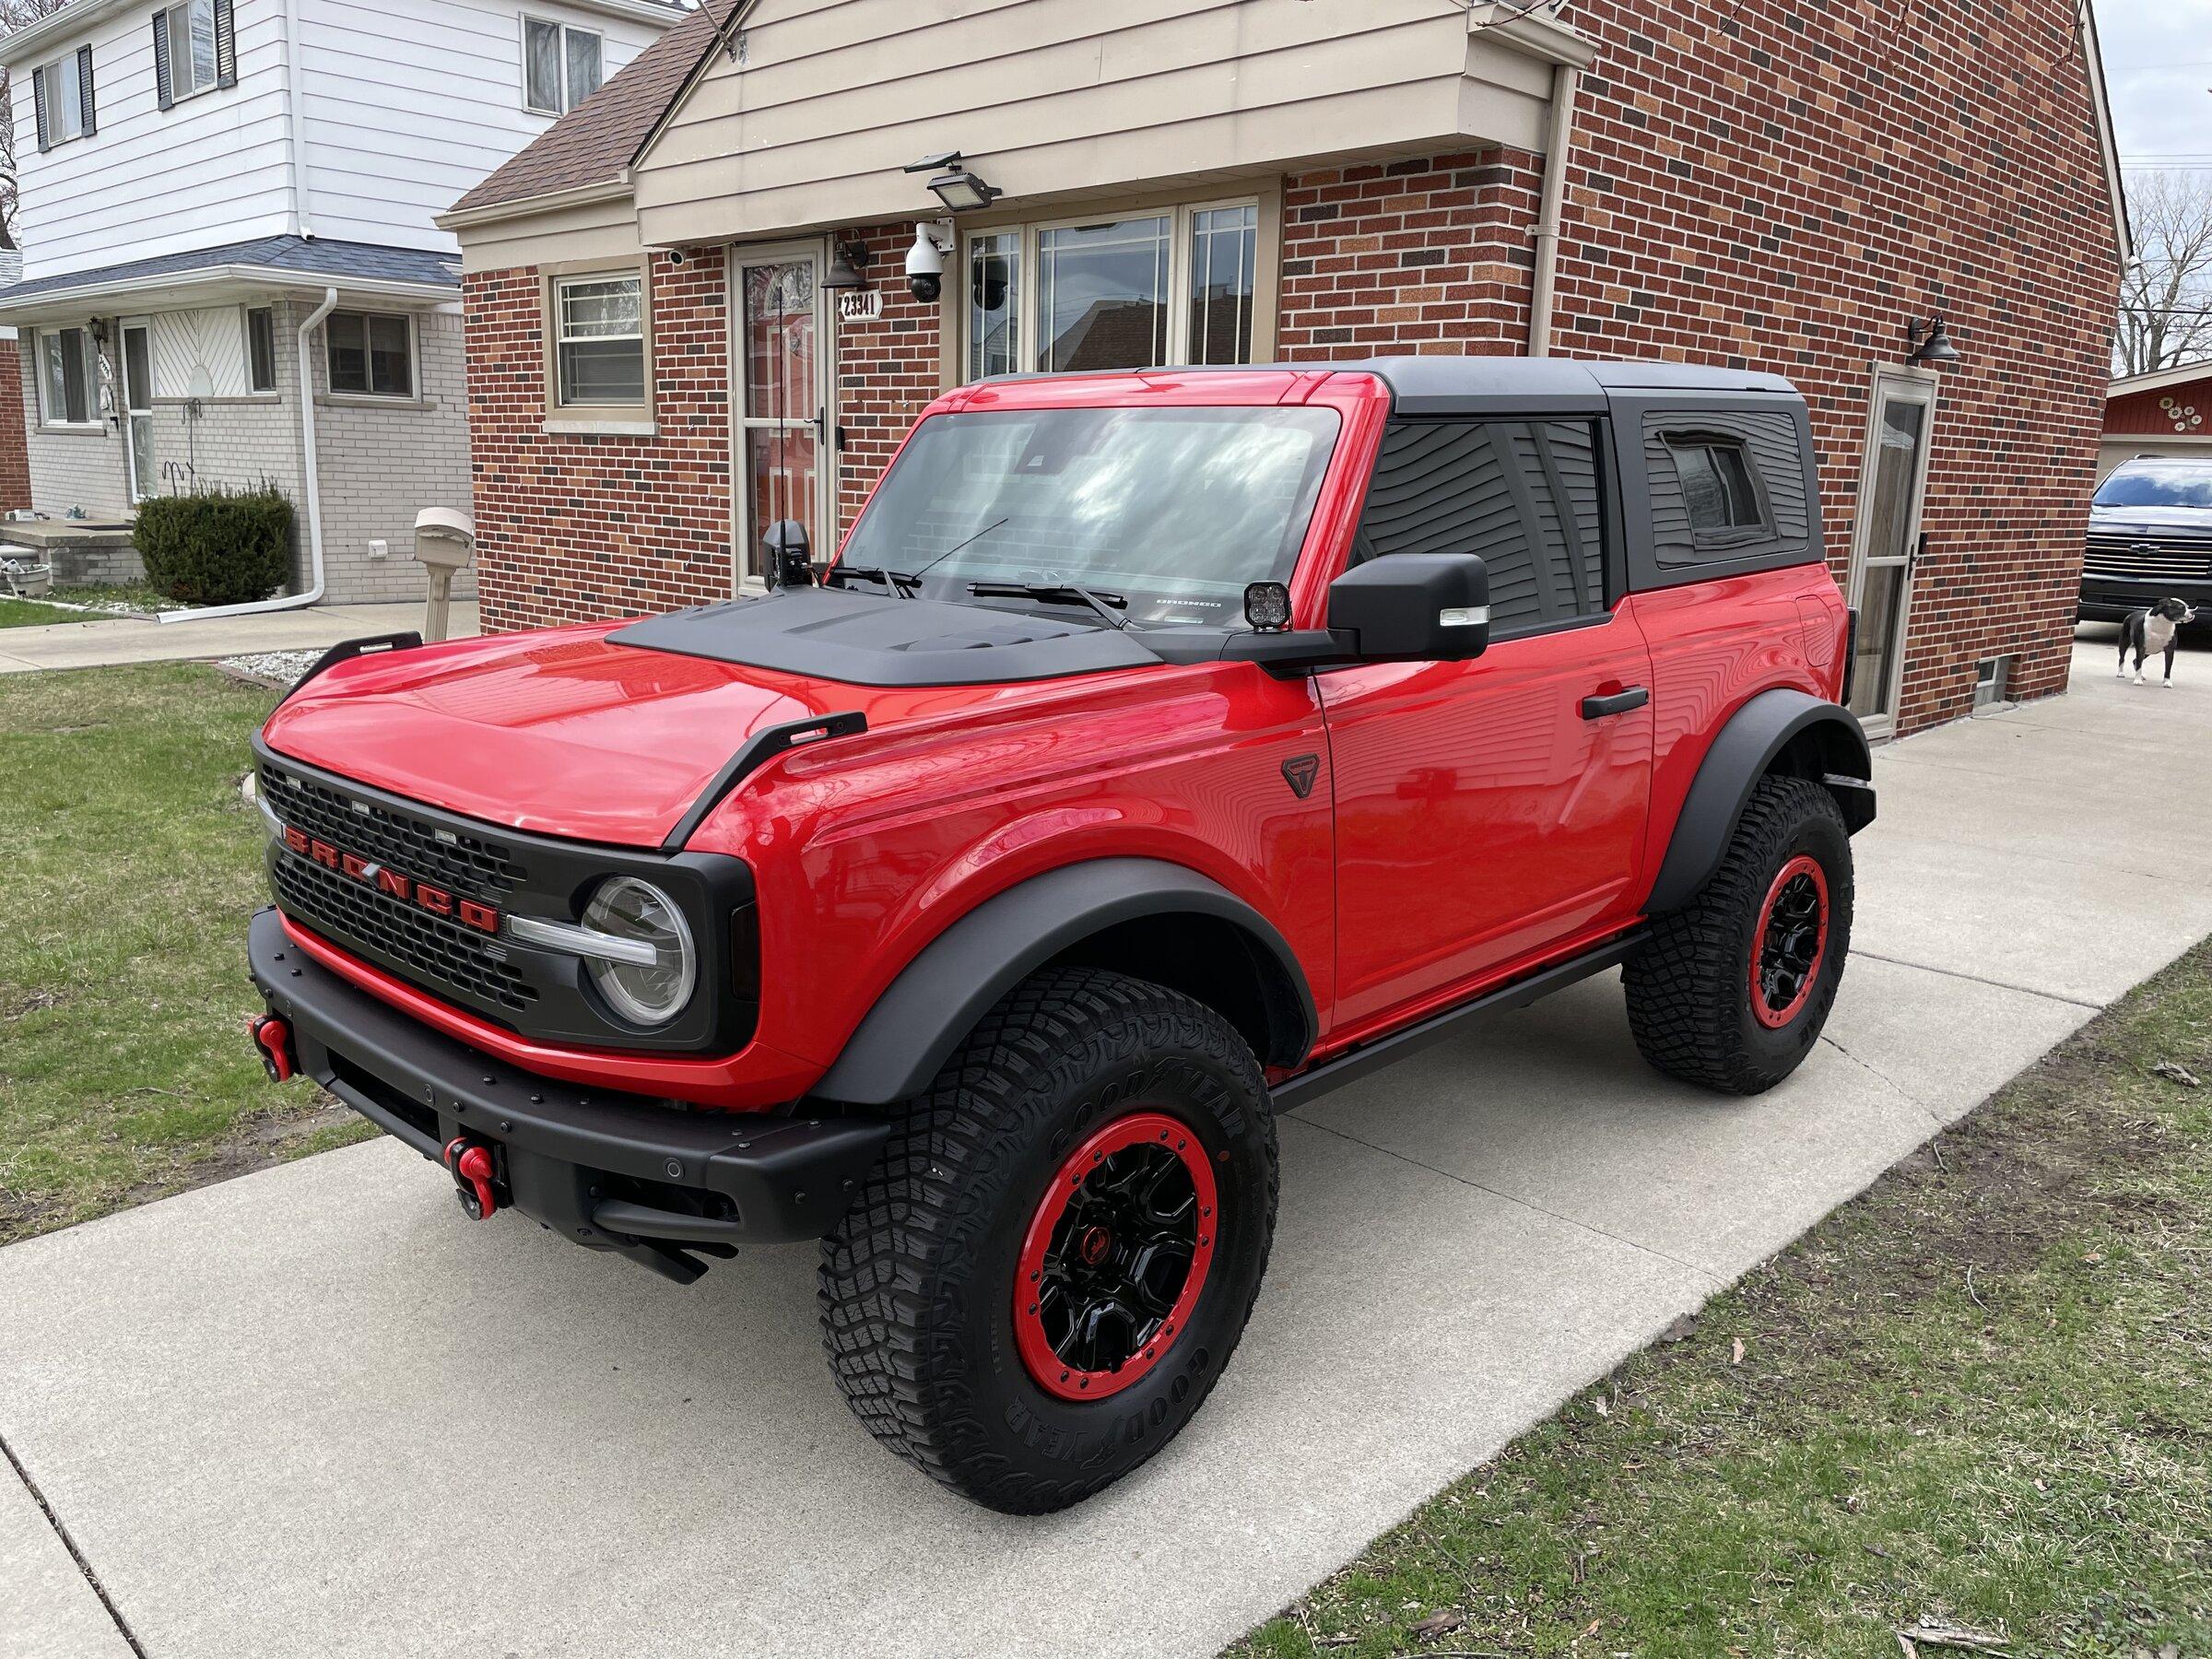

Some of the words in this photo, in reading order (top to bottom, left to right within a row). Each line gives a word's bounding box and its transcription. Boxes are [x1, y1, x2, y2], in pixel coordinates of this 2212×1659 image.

[844, 294, 875, 316] 23341
[1157, 599, 1221, 607] BRONCO
[285, 826, 499, 933] BRONCO
